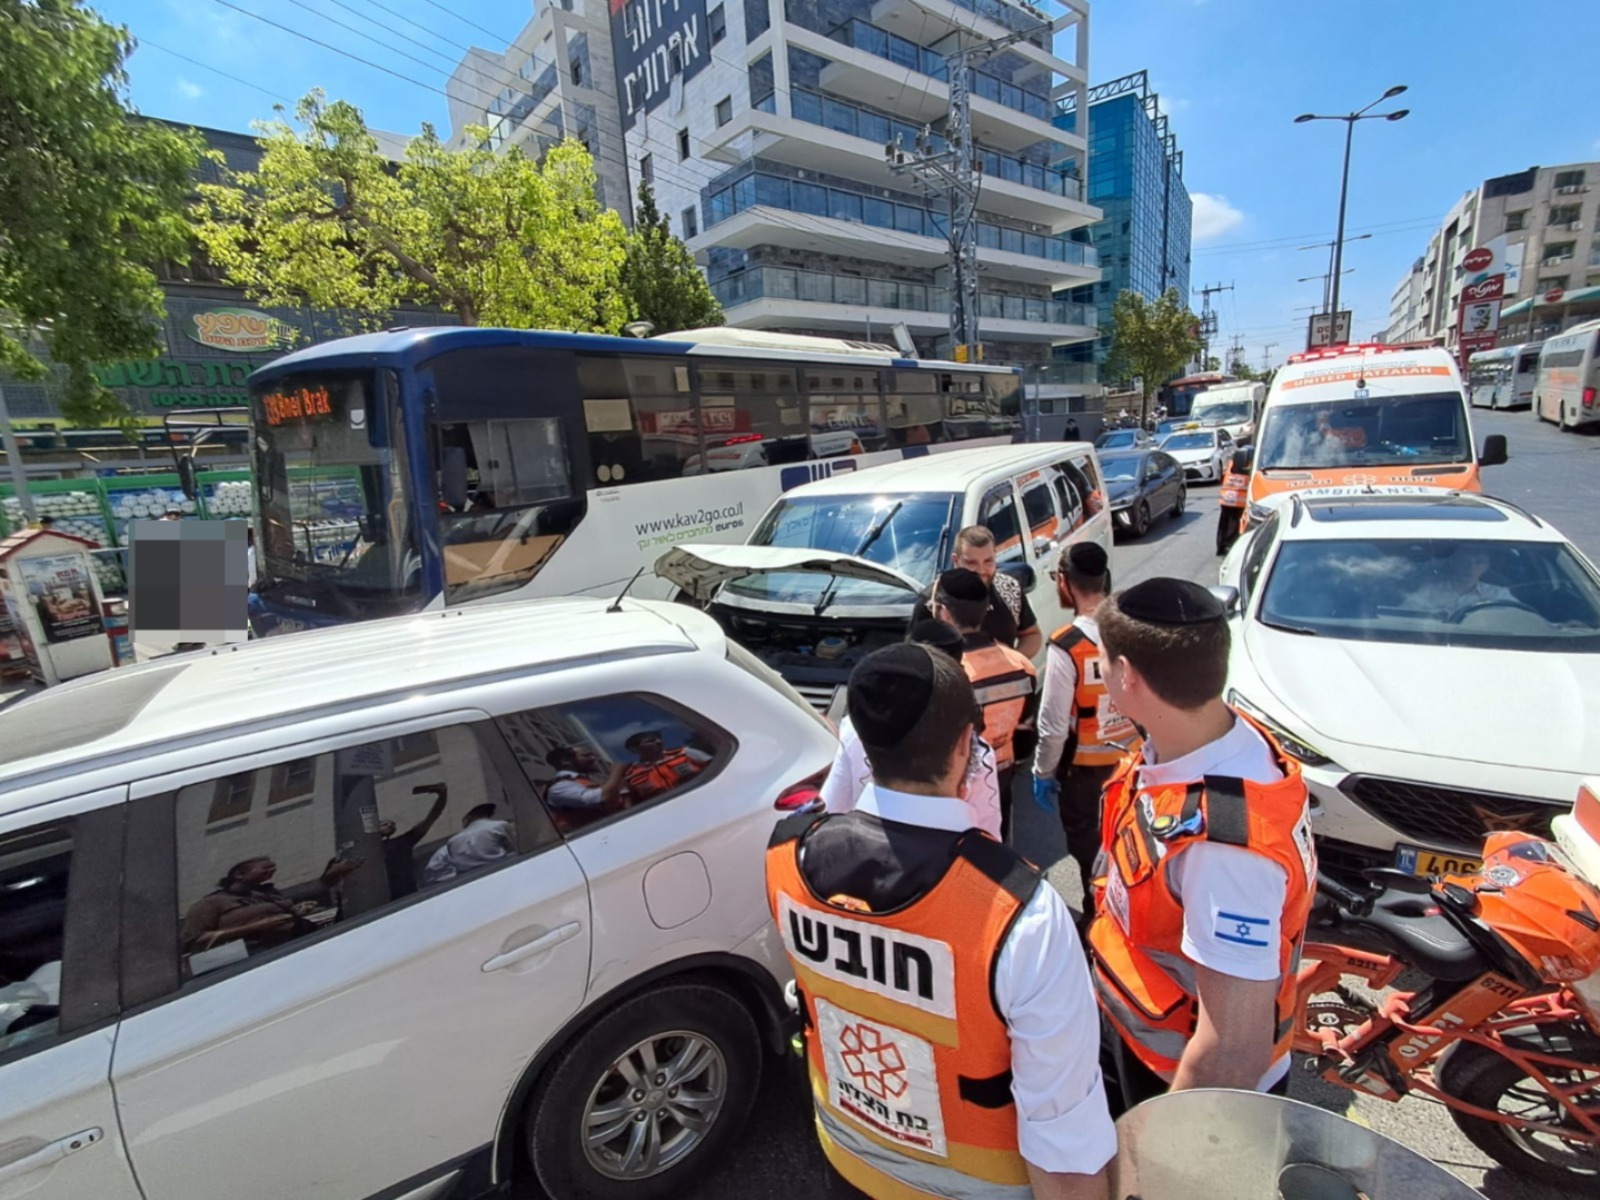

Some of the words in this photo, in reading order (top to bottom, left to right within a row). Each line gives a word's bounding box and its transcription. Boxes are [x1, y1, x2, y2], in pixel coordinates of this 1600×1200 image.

[1293, 374, 1346, 387] UNITED
[1352, 366, 1433, 380] HATZALAH
[302, 385, 332, 416] Brak
[1302, 486, 1430, 496] AMBUANCE
[635, 501, 744, 536] www.kav2go.co.il
[789, 909, 934, 1001] חובש
